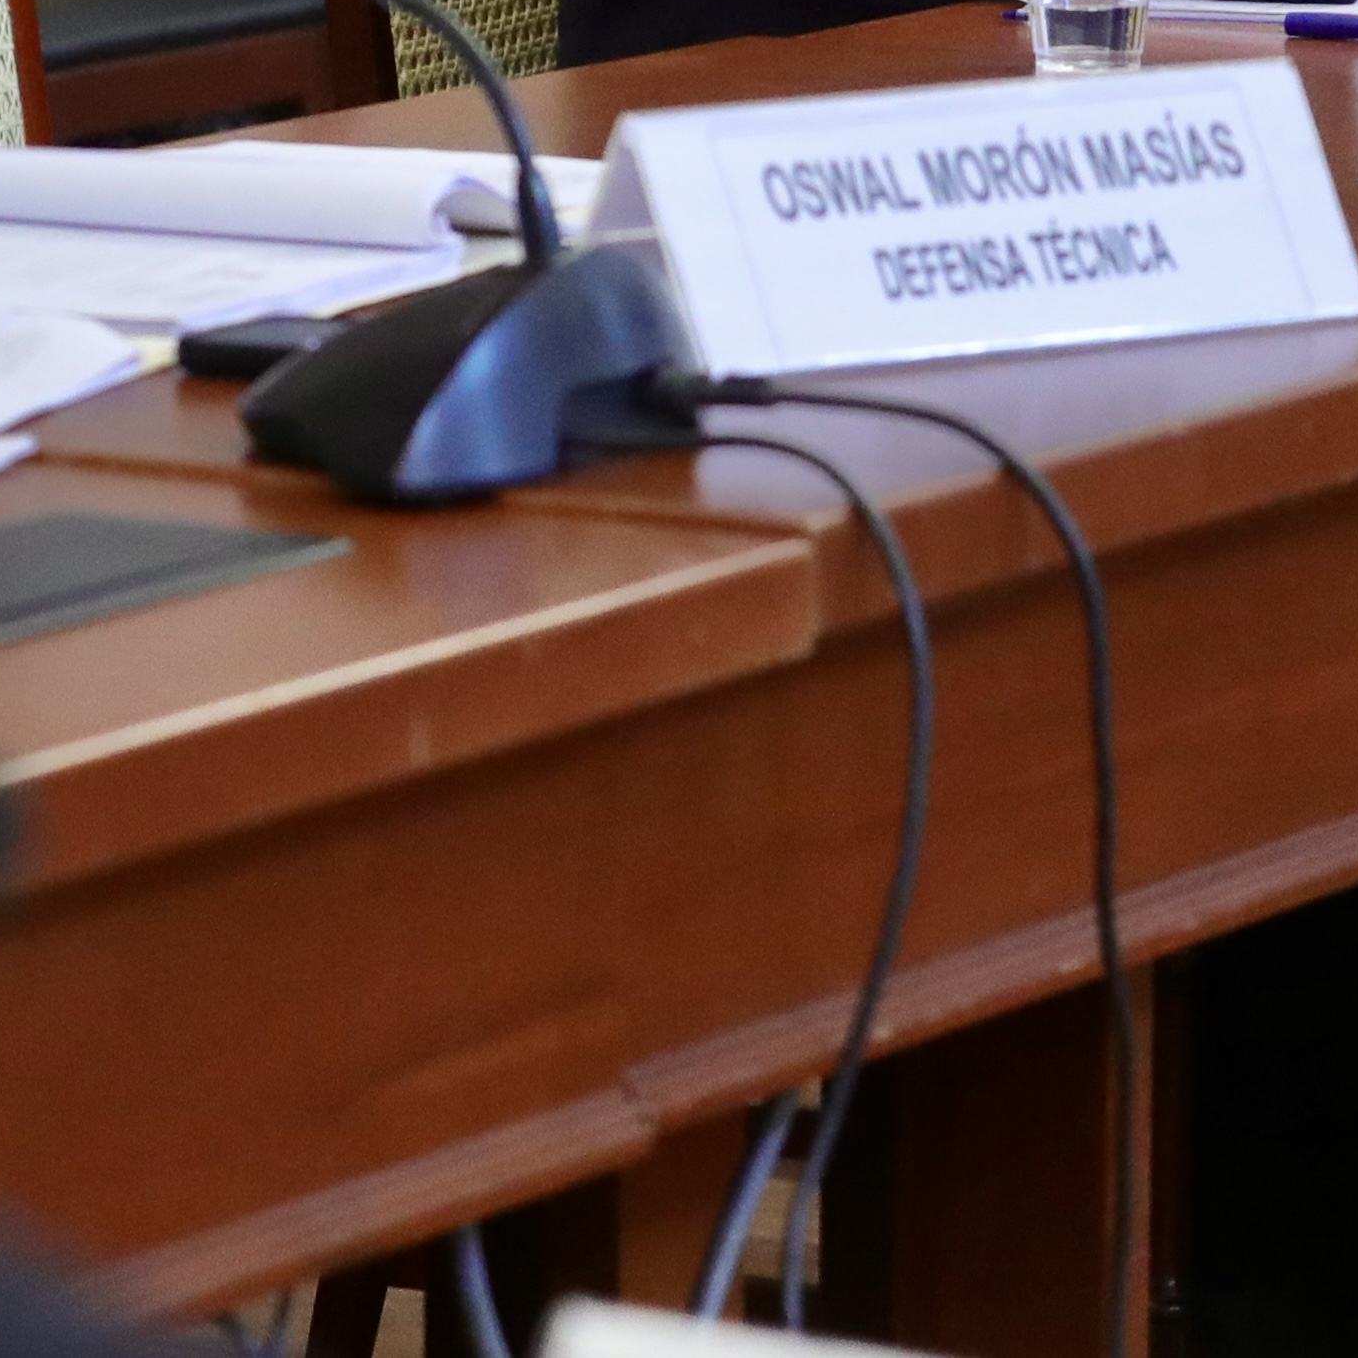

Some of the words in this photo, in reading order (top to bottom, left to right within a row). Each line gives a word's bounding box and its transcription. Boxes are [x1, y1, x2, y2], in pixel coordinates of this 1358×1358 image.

[761, 156, 923, 221] OSWAL
[919, 125, 1082, 205] MORÓN
[1082, 110, 1246, 189] MASÍAS
[871, 235, 1030, 301] DEFENSA
[1029, 218, 1176, 285] TÉCNICA
